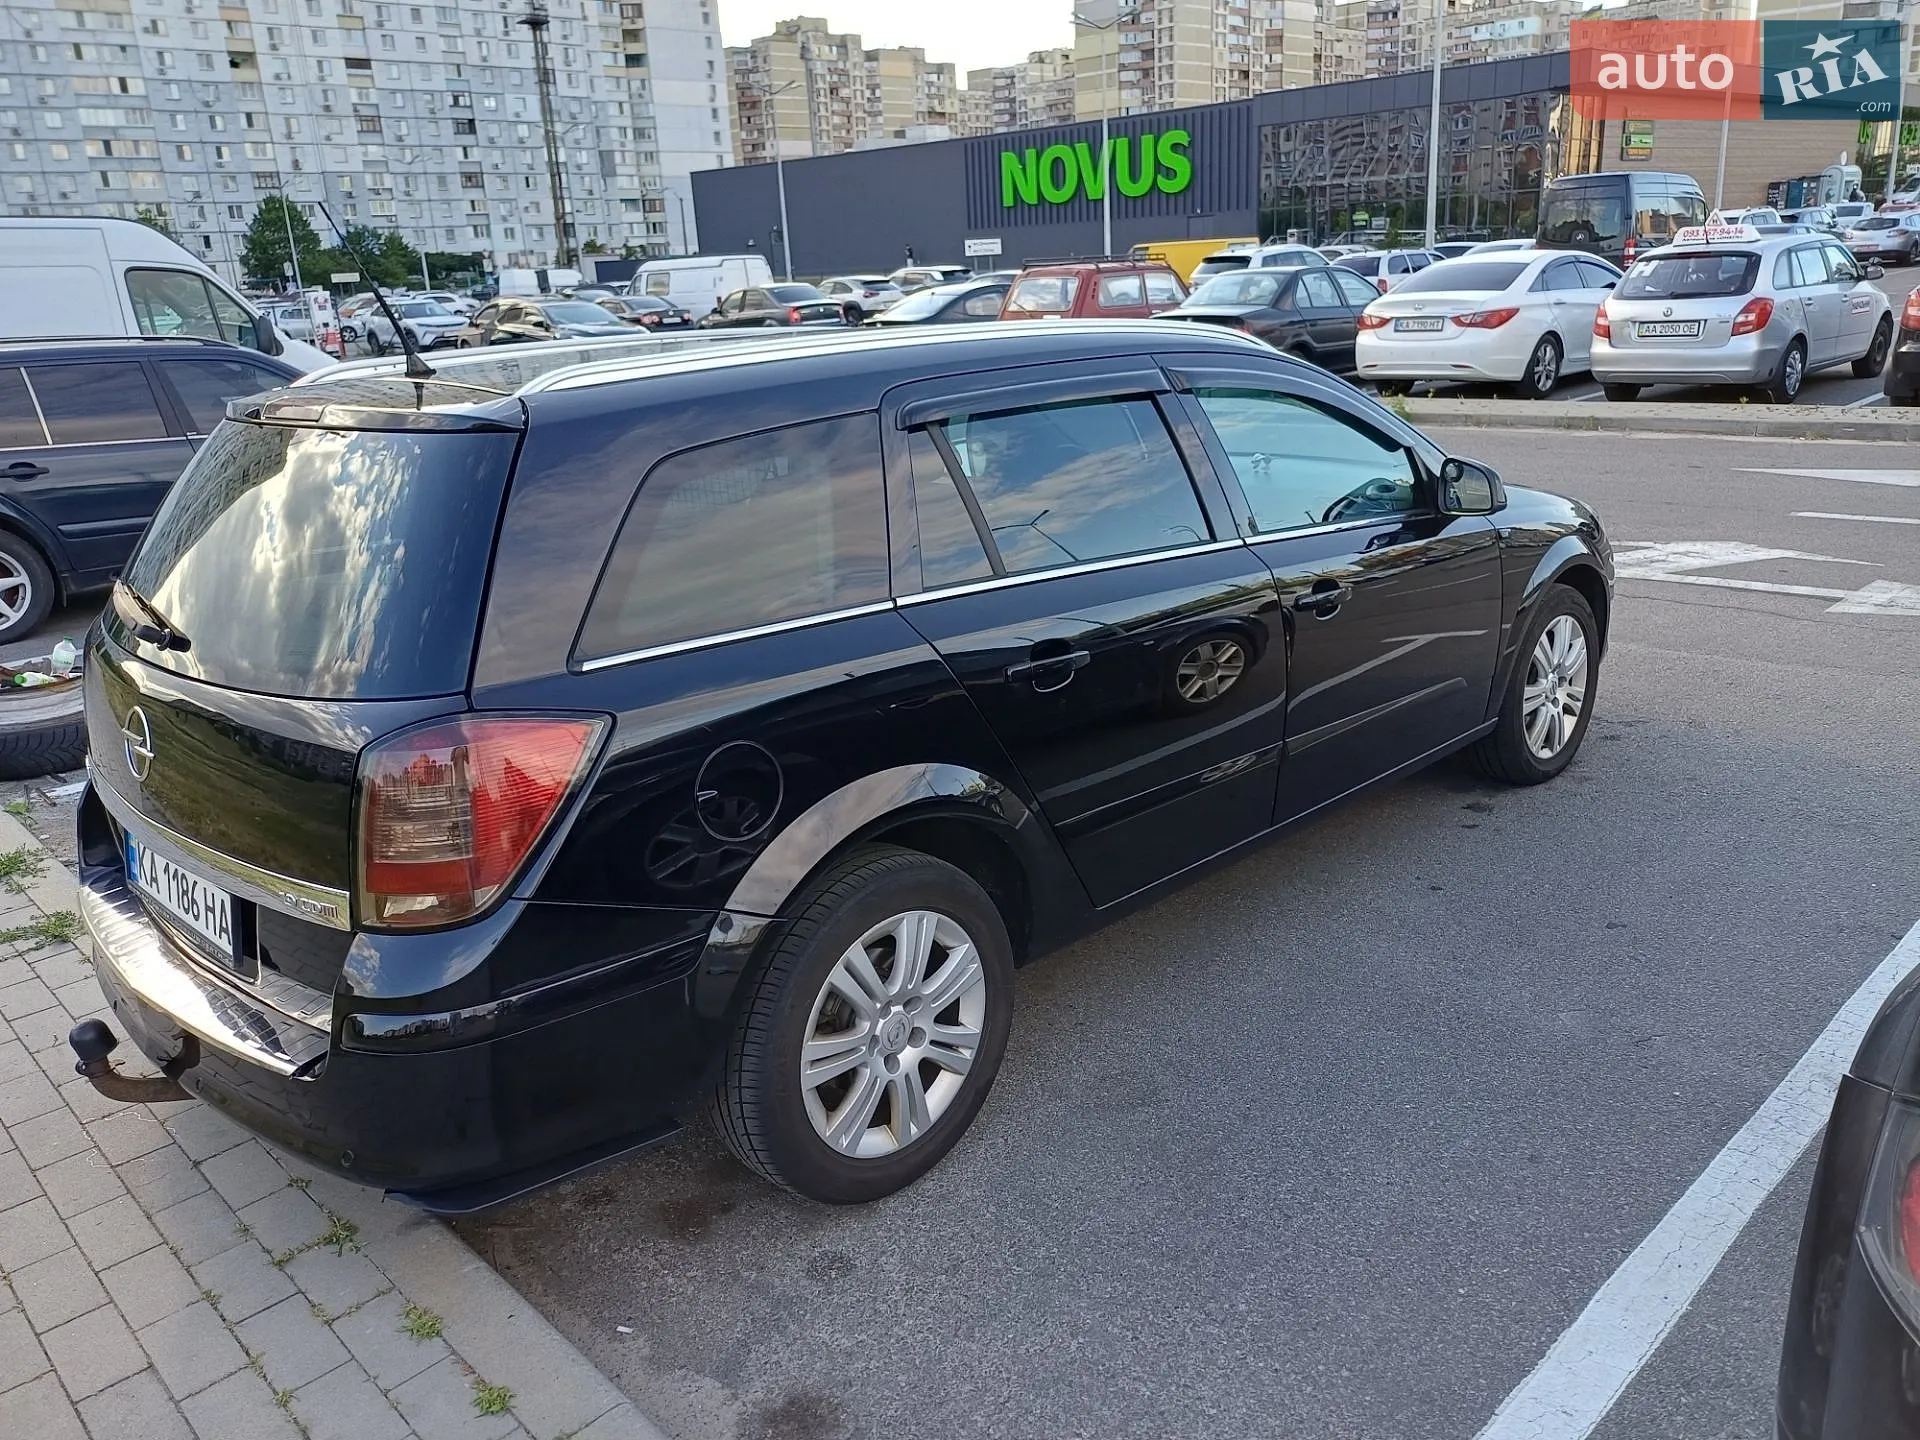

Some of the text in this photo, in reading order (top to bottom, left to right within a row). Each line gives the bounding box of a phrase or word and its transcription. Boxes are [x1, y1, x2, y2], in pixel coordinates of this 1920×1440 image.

[1001, 129, 1193, 208] NOVUS
[1645, 323, 1697, 334] AA 2050 OE
[137, 841, 160, 895] KA
[163, 861, 201, 922] 1186
[203, 886, 232, 947] HA
